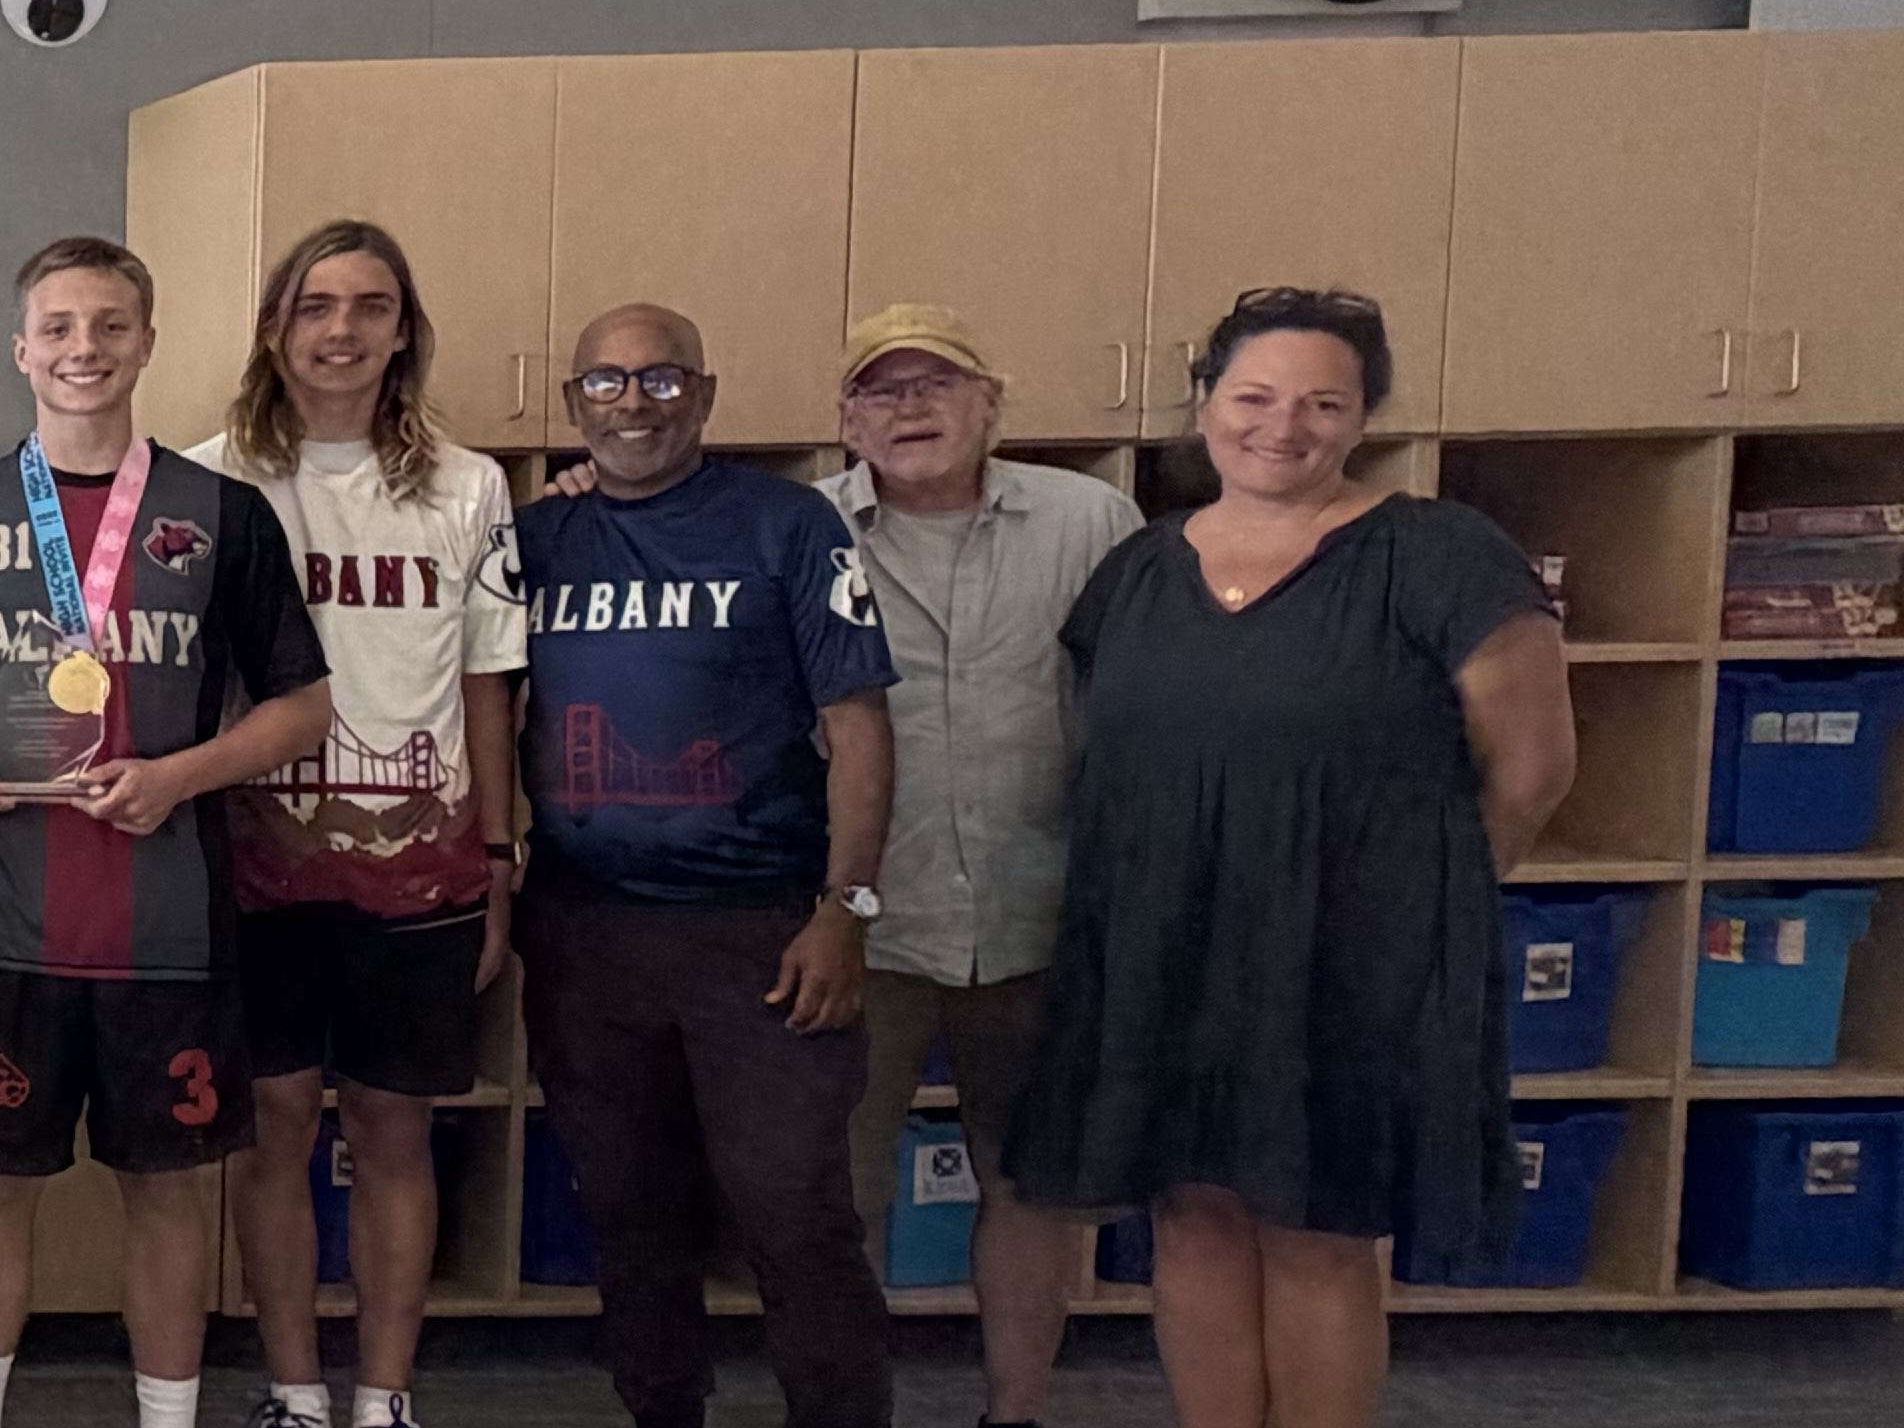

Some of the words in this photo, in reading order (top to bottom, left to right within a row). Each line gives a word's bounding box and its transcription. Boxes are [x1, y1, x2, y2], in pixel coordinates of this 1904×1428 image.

[41, 537, 65, 597] SCHOOL
[304, 551, 441, 610] BANY
[527, 578, 743, 637] ALBANY
[167, 1046, 220, 1127] 3
